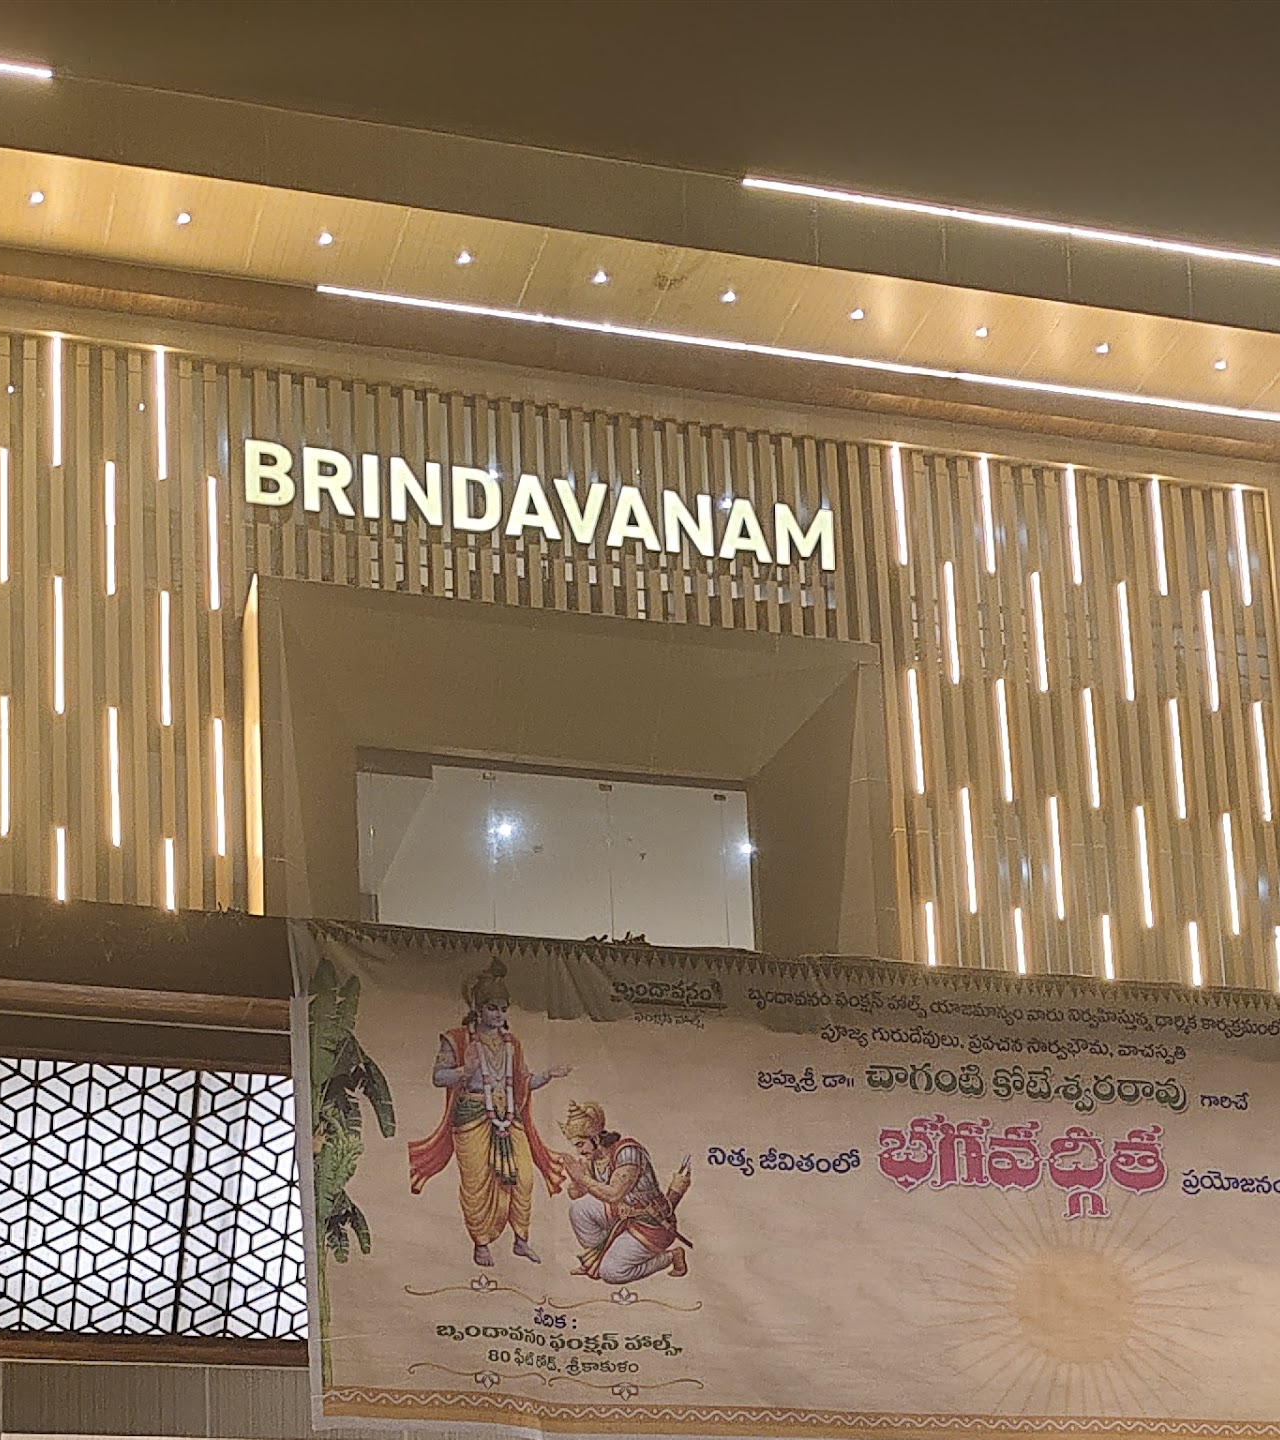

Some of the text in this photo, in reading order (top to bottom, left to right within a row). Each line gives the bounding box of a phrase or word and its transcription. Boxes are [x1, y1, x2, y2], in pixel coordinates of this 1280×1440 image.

[243, 438, 836, 571] BRINDAVANAM
[748, 988, 831, 1010] బృందావనం
[929, 999, 1023, 1026] యాజమాన్యం
[1027, 1007, 1063, 1022] వారు
[1070, 1006, 1153, 1032] నిర్వహిస్తున్న
[821, 1024, 868, 1047] పూజ్య
[969, 1033, 1022, 1054] ప్రవచన
[1118, 1043, 1187, 1065] వాచస్పతి
[757, 1067, 817, 1092] బ్రహ్మశ్రీ
[865, 1061, 984, 1097] చాగంటి
[993, 1065, 1187, 1112] కోటేశ్వరరావు
[1200, 1092, 1250, 1111] గారిచే
[707, 1146, 754, 1176] నిత్య
[759, 1147, 861, 1174] జీవితంలో
[436, 1323, 546, 1346] బృందావనం
[549, 1332, 619, 1356] ఫంక్షన్
[488, 1350, 511, 1362] 80
[565, 1357, 639, 1377] శ్రీకాకుళం
